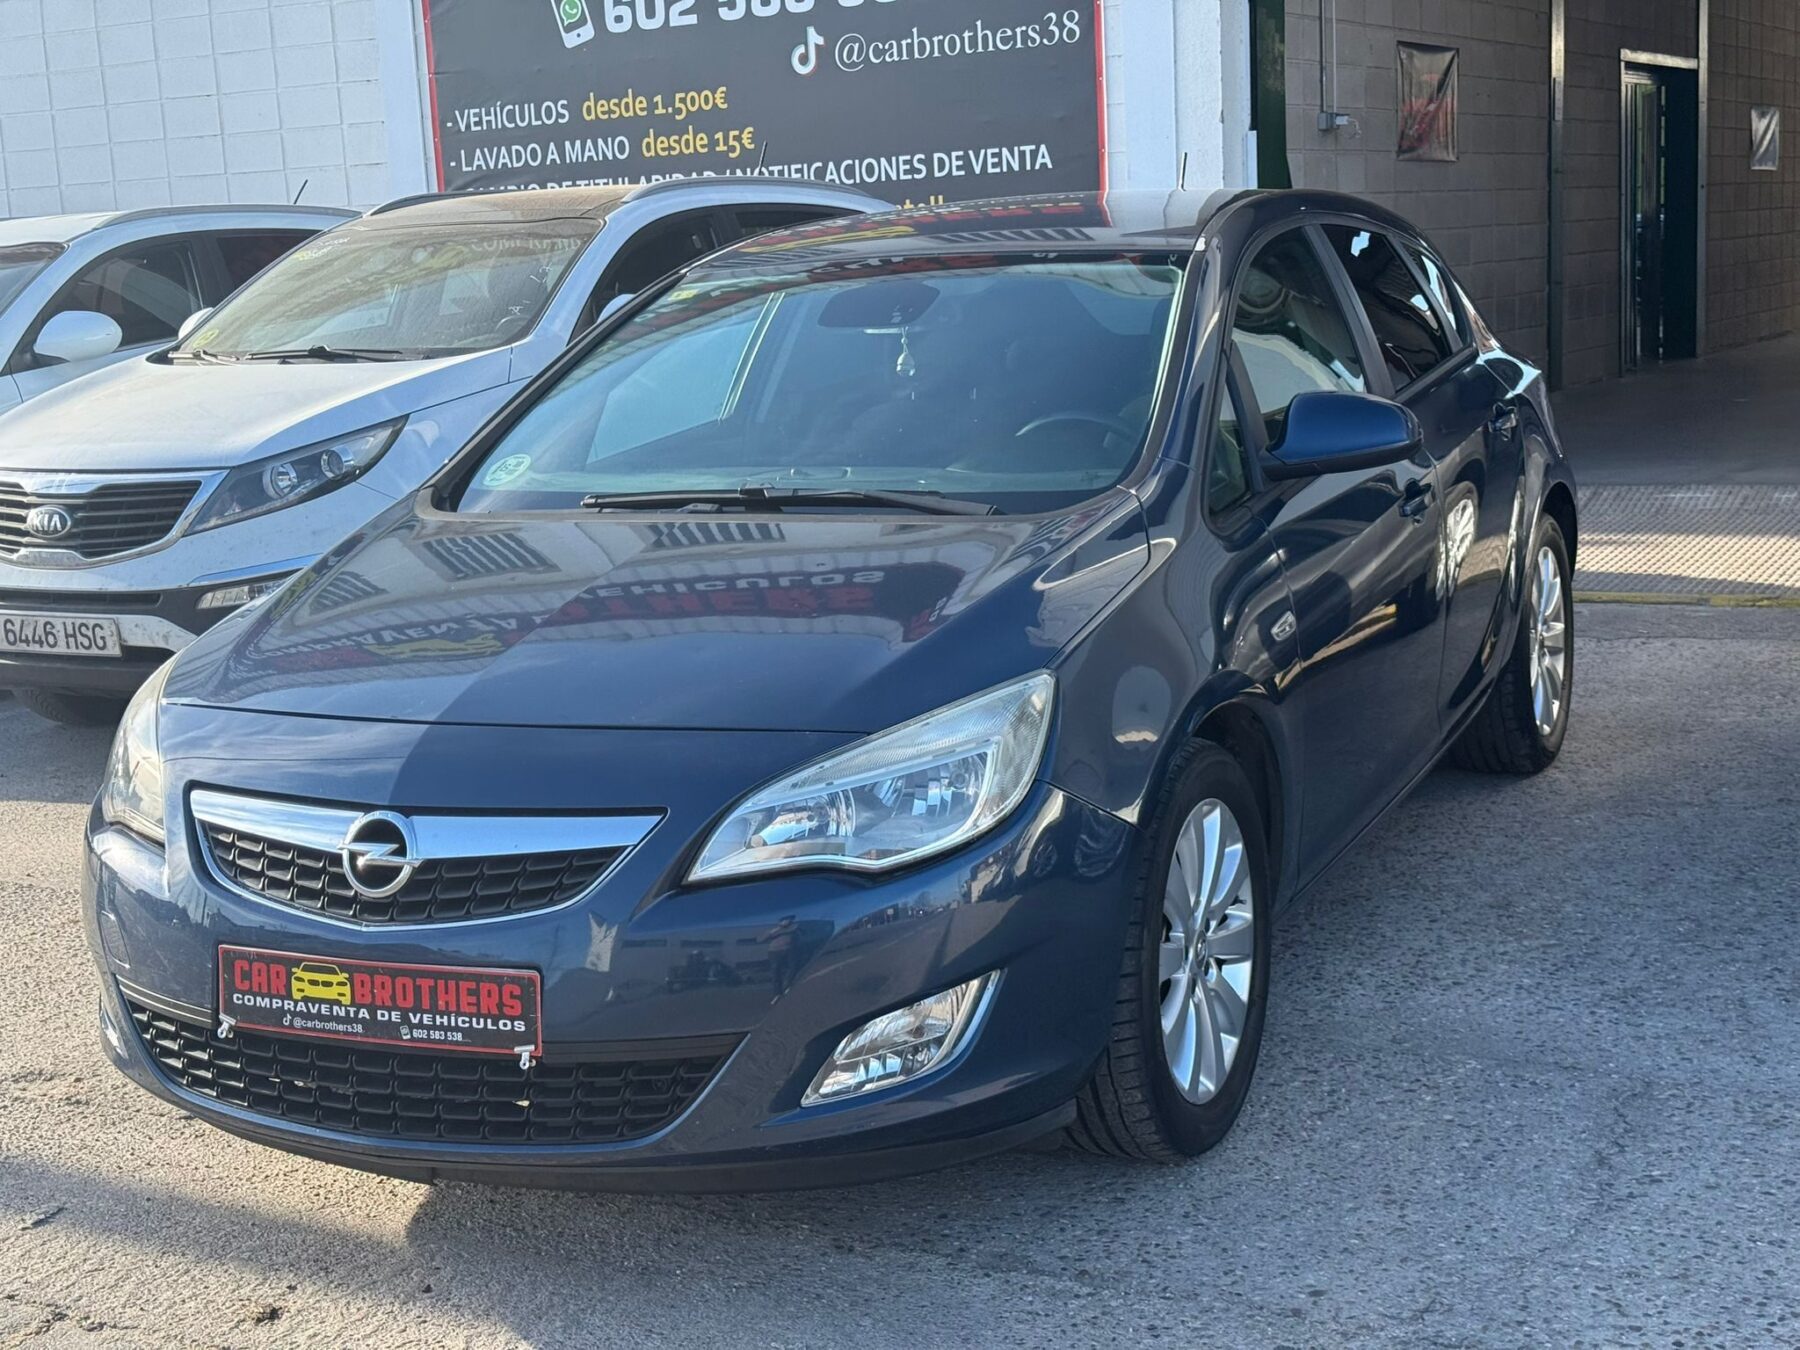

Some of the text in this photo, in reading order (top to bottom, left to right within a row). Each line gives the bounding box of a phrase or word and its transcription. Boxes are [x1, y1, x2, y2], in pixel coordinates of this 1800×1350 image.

[835, 10, 1080, 72] @carbrothers38
[455, 99, 570, 132] VEHÍCULOS
[582, 88, 647, 122] desde
[653, 86, 728, 121] 1.500€
[461, 143, 541, 172] LAVADO
[546, 141, 561, 165] A
[565, 135, 630, 163] MANO
[641, 125, 709, 158] desde
[714, 126, 755, 158] 15€
[933, 150, 964, 178] DE
[968, 143, 1053, 173] VENTA
[33, 513, 62, 531] KIA
[4, 618, 58, 648] 6446
[63, 621, 107, 650] HSG
[233, 959, 522, 1017] CAR BROTHERS
[233, 993, 526, 1032] COMPRAVENTA DE VEHÍCULOS
[293, 1017, 363, 1033] @carbrothers38
[412, 1028, 463, 1041] 602 583 538
